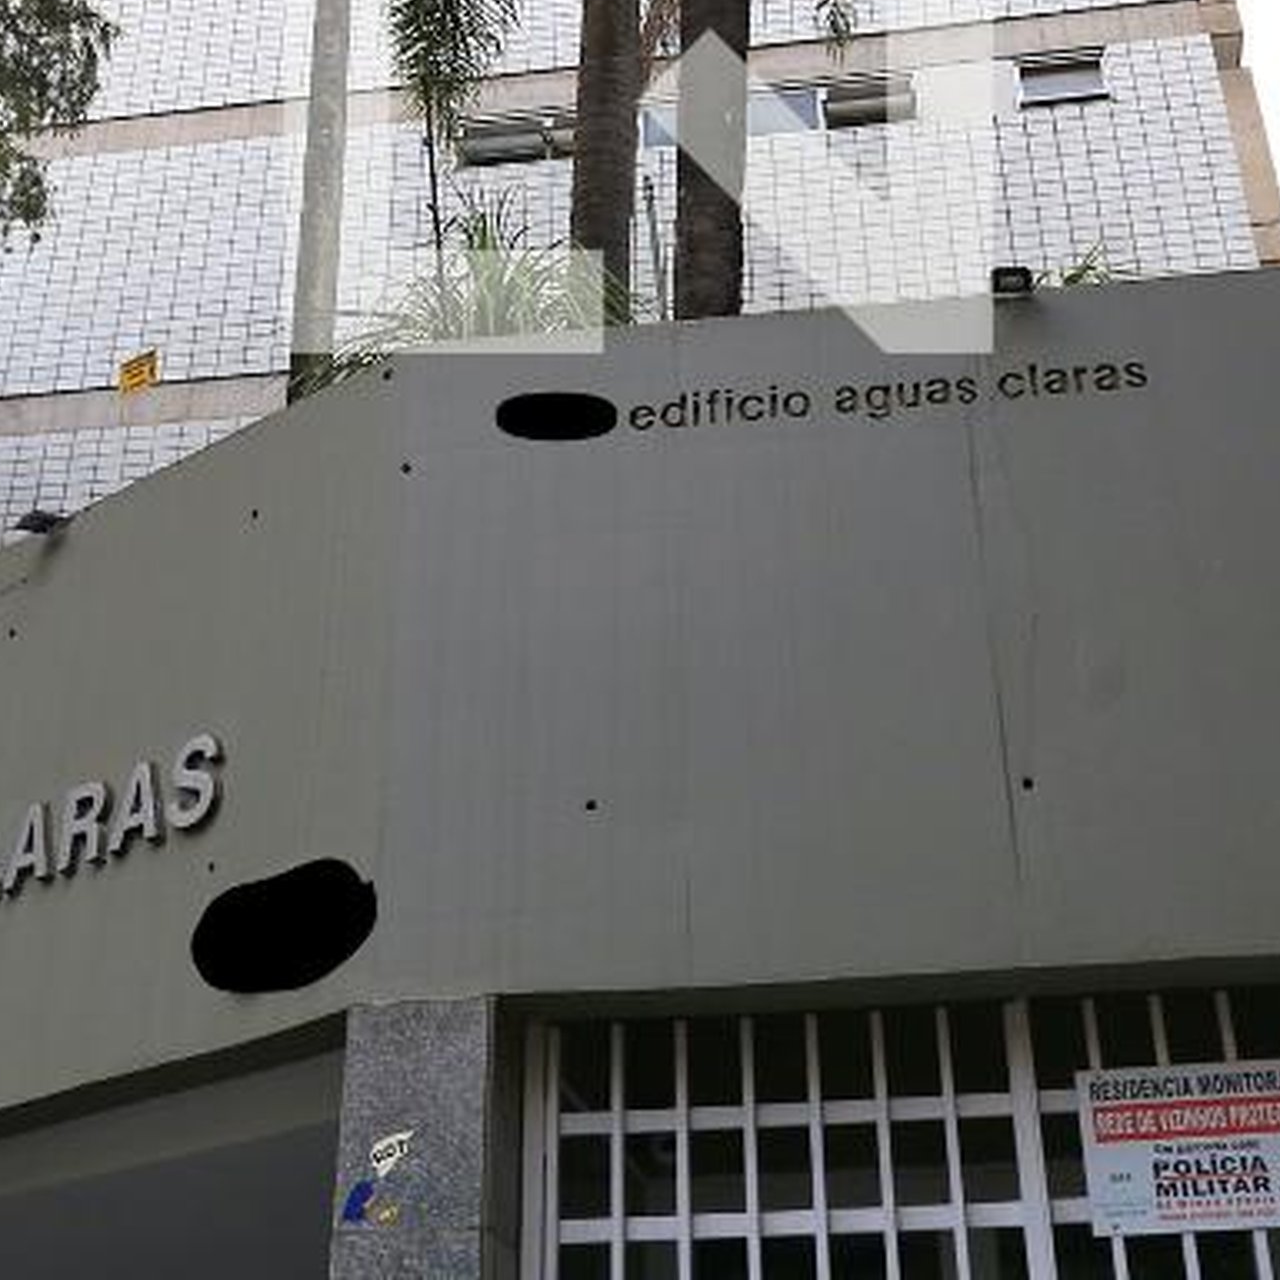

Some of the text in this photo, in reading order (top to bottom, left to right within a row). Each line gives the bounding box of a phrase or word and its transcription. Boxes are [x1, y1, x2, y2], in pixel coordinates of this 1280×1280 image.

[628, 359, 1149, 430] edificio aguas claras
[1155, 1176, 1271, 1198] MILITAR
